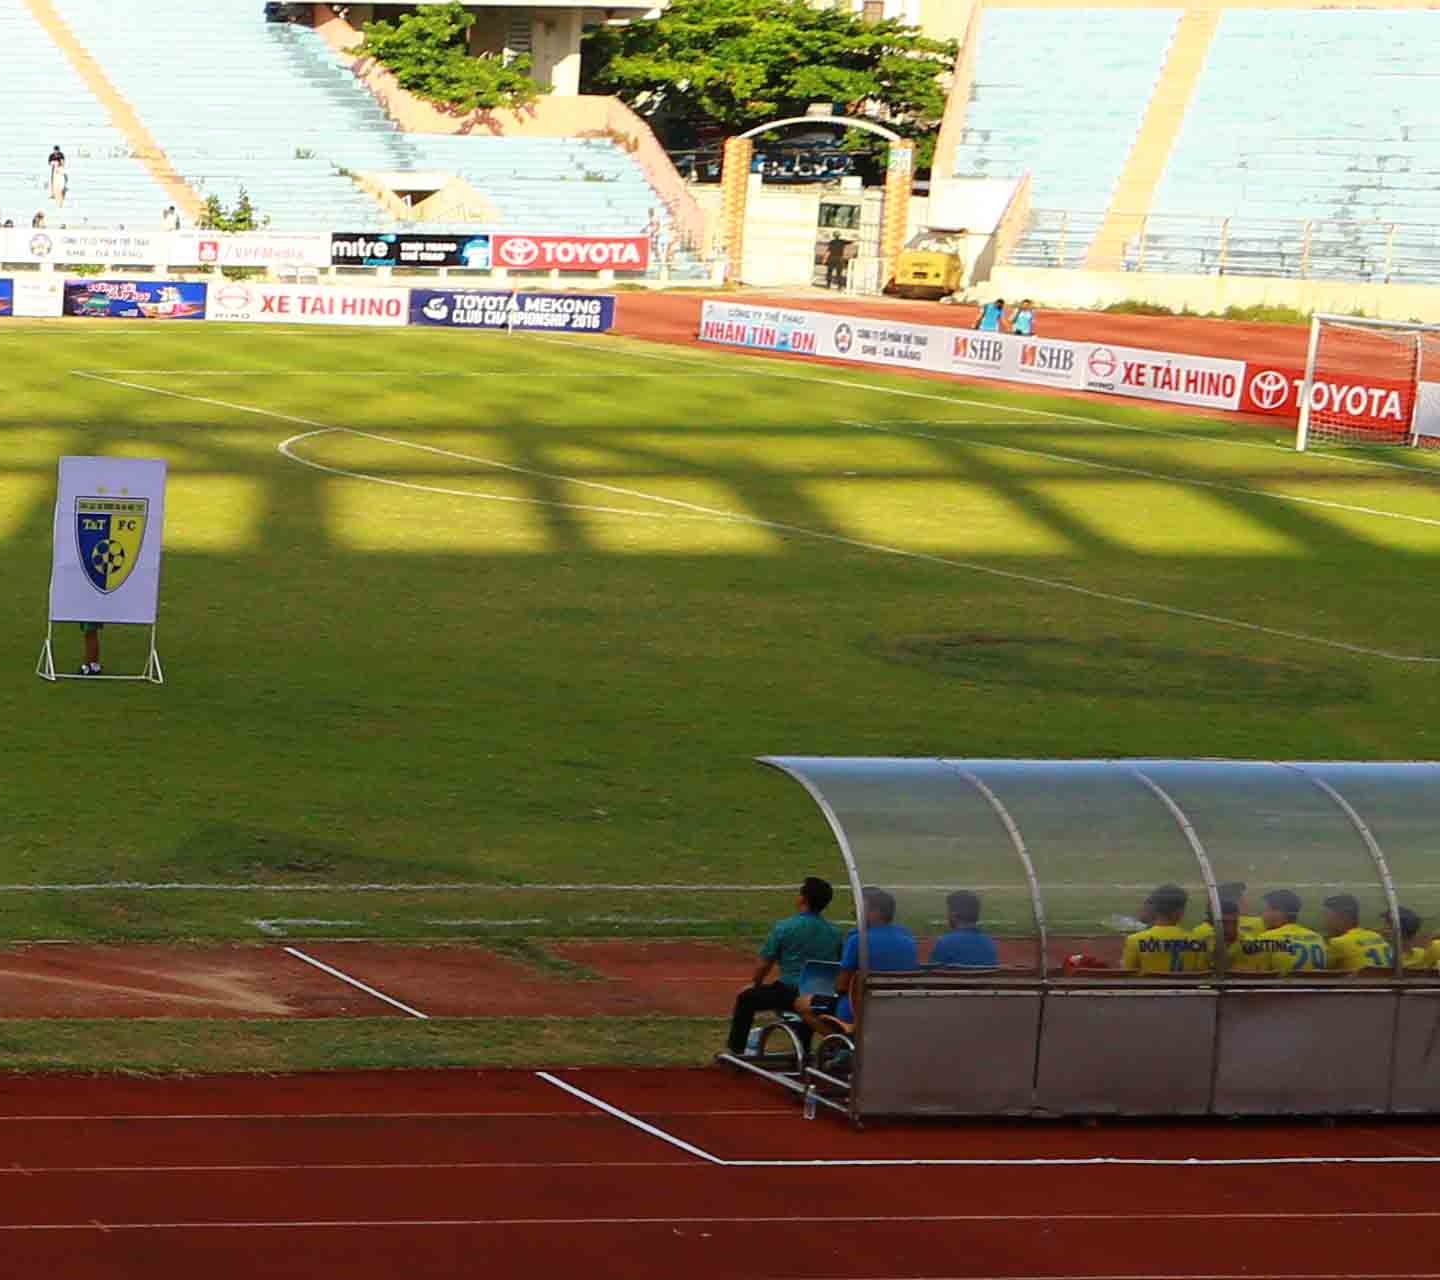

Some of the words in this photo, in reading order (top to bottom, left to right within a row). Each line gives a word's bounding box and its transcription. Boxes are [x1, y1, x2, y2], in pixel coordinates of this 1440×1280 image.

[332, 237, 388, 257] mitre
[540, 241, 640, 263] TOYOTA
[259, 295, 291, 315] XE
[341, 297, 401, 318] HINO
[453, 294, 522, 311] TOYOTA
[525, 297, 600, 314] MEKONG
[452, 309, 482, 324] CLUB
[570, 314, 601, 329] 2016
[970, 339, 1003, 362] SHB
[1036, 345, 1073, 371] SHB
[1120, 360, 1146, 387] XE
[1184, 369, 1236, 400] HINO
[1292, 379, 1403, 420] TOYOTA
[118, 519, 137, 531] FC
